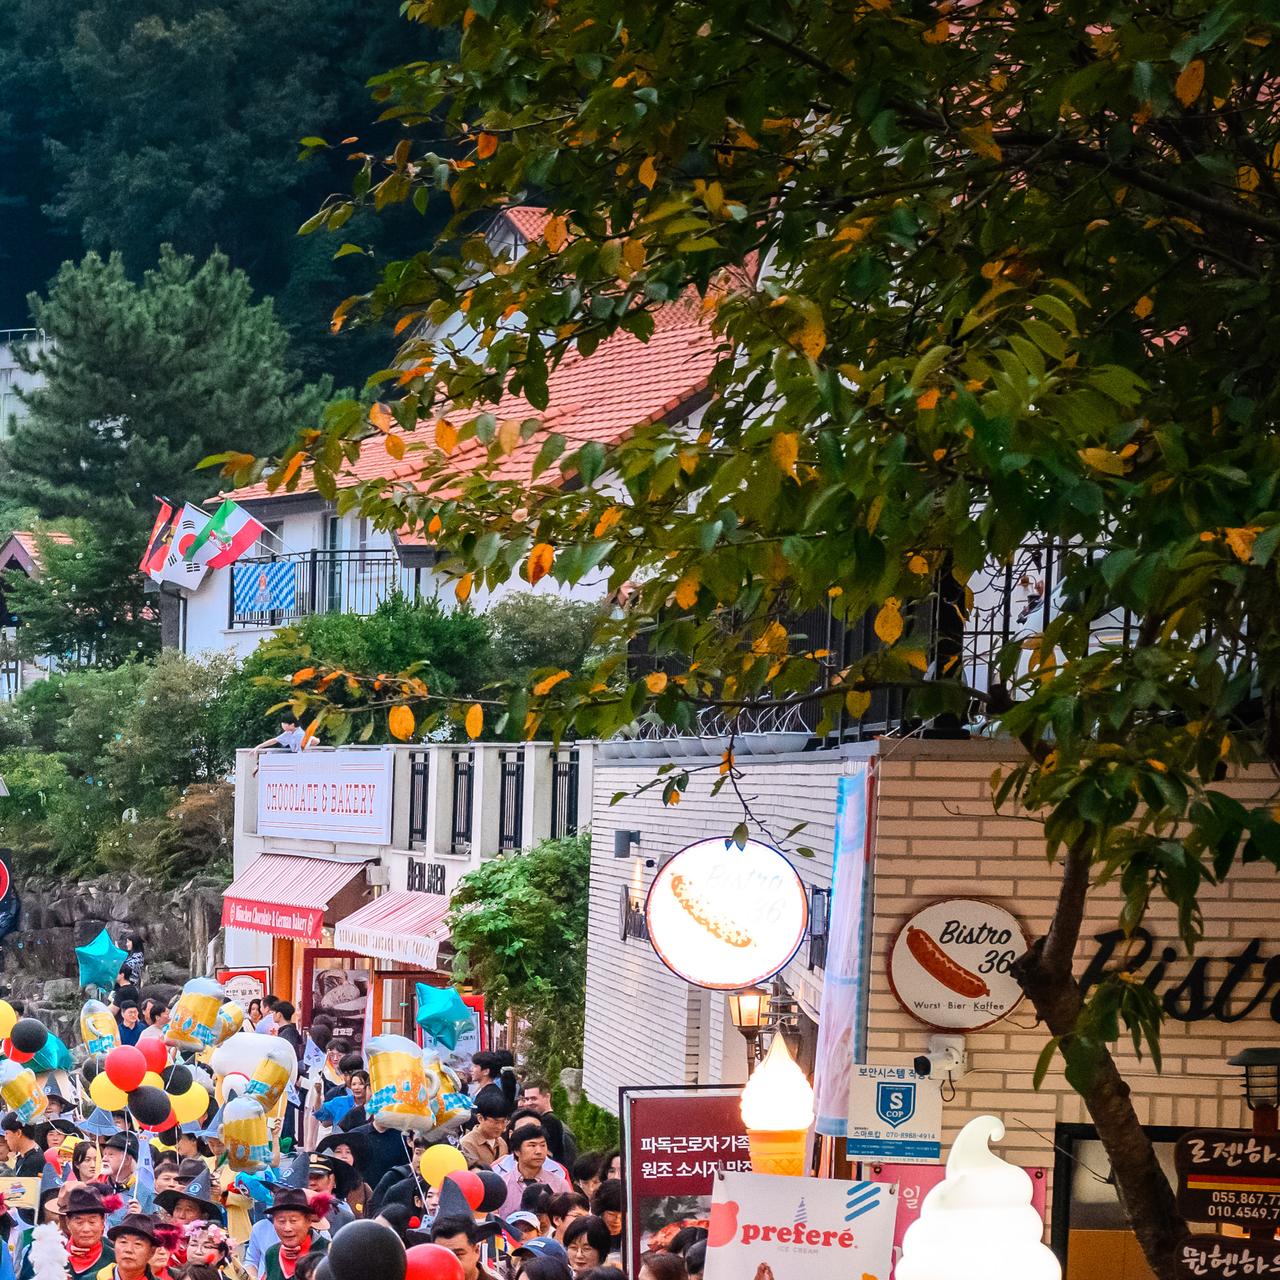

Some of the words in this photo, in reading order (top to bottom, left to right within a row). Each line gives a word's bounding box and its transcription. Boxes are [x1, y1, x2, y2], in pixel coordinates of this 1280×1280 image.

[266, 782, 319, 812] CHOCOLATE
[330, 784, 376, 815] BAKERY
[939, 919, 1012, 945] Bistro
[977, 950, 1016, 974] 36
[914, 1001, 941, 1010] Wurst
[947, 1001, 967, 1010] Bier
[973, 1001, 1005, 1011] Kaffee
[889, 1092, 904, 1110] S
[886, 1110, 905, 1118] COP
[640, 1135, 720, 1154] 파독근로자
[1187, 1137, 1280, 1167] 로젠하
[641, 1161, 673, 1179] 원조
[741, 1222, 855, 1249] preferé
